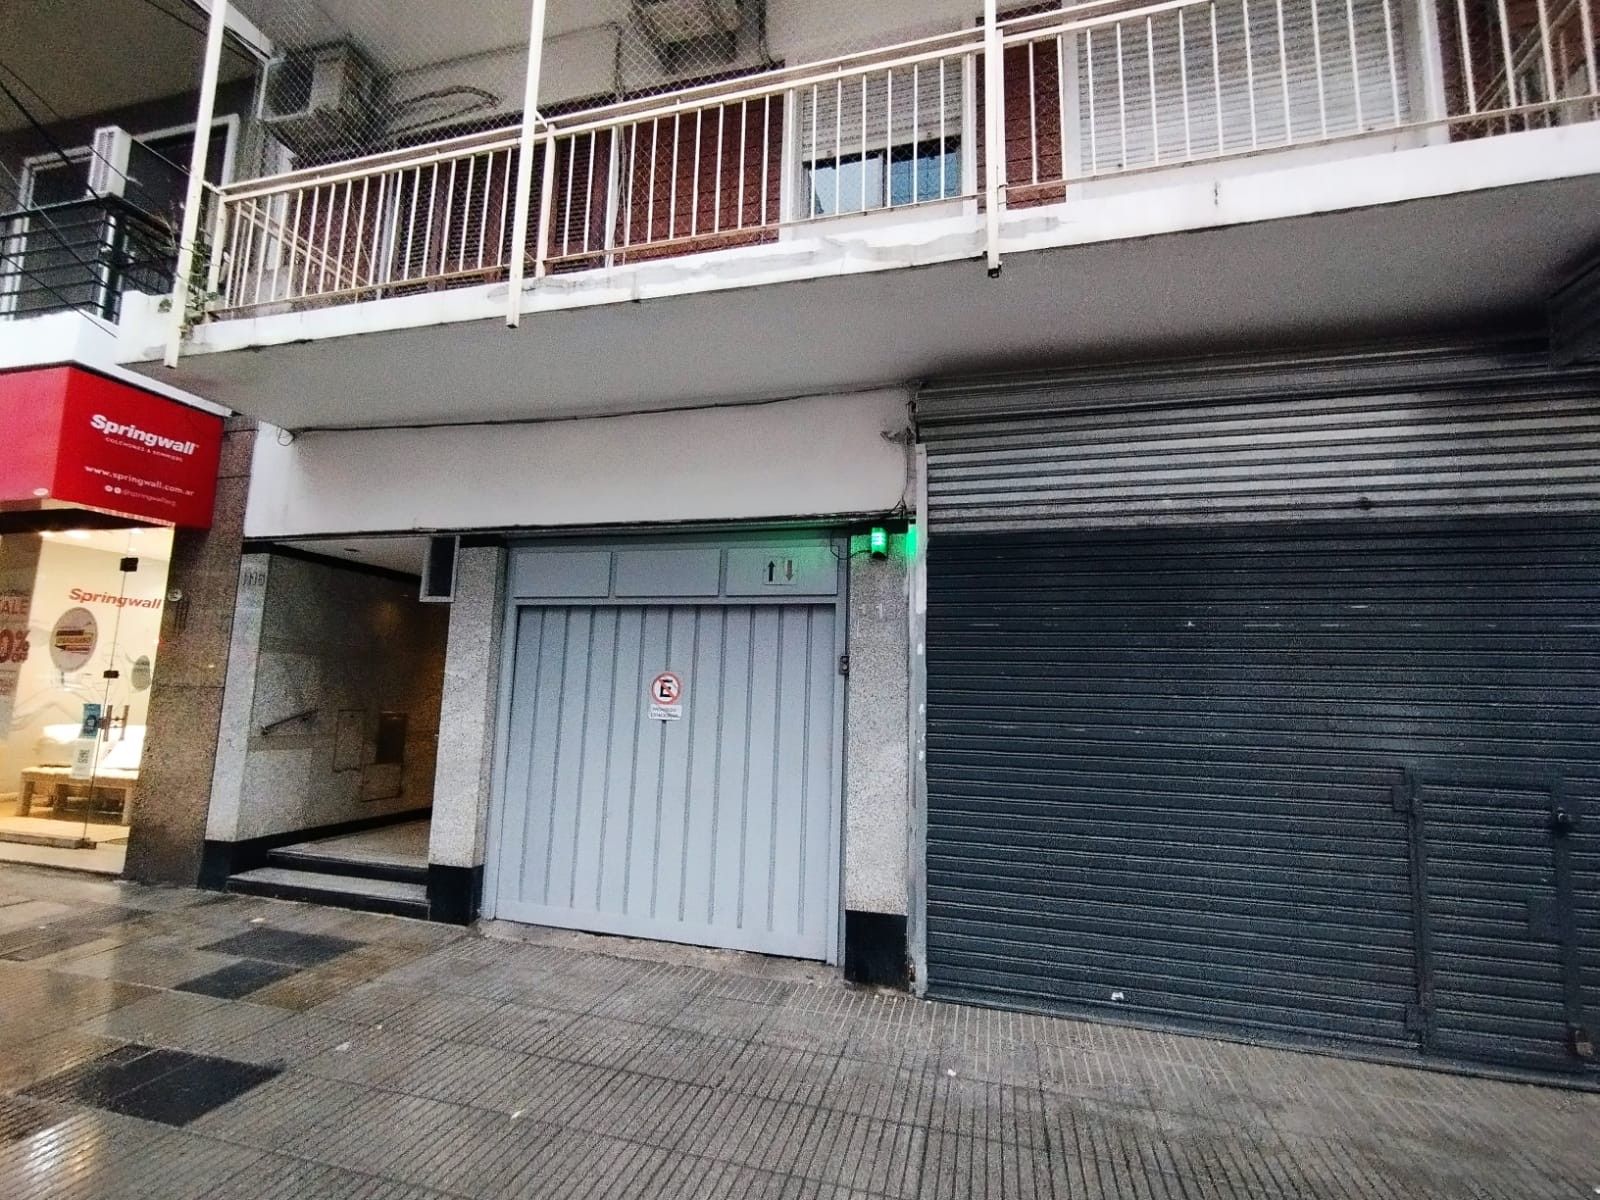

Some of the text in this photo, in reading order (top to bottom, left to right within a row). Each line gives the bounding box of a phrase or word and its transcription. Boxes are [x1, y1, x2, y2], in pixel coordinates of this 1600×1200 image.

[90, 413, 196, 455] Springwall
[84, 465, 195, 496] www.springwall.com.ar
[0, 598, 28, 615] ALE
[69, 587, 162, 609] Springwall
